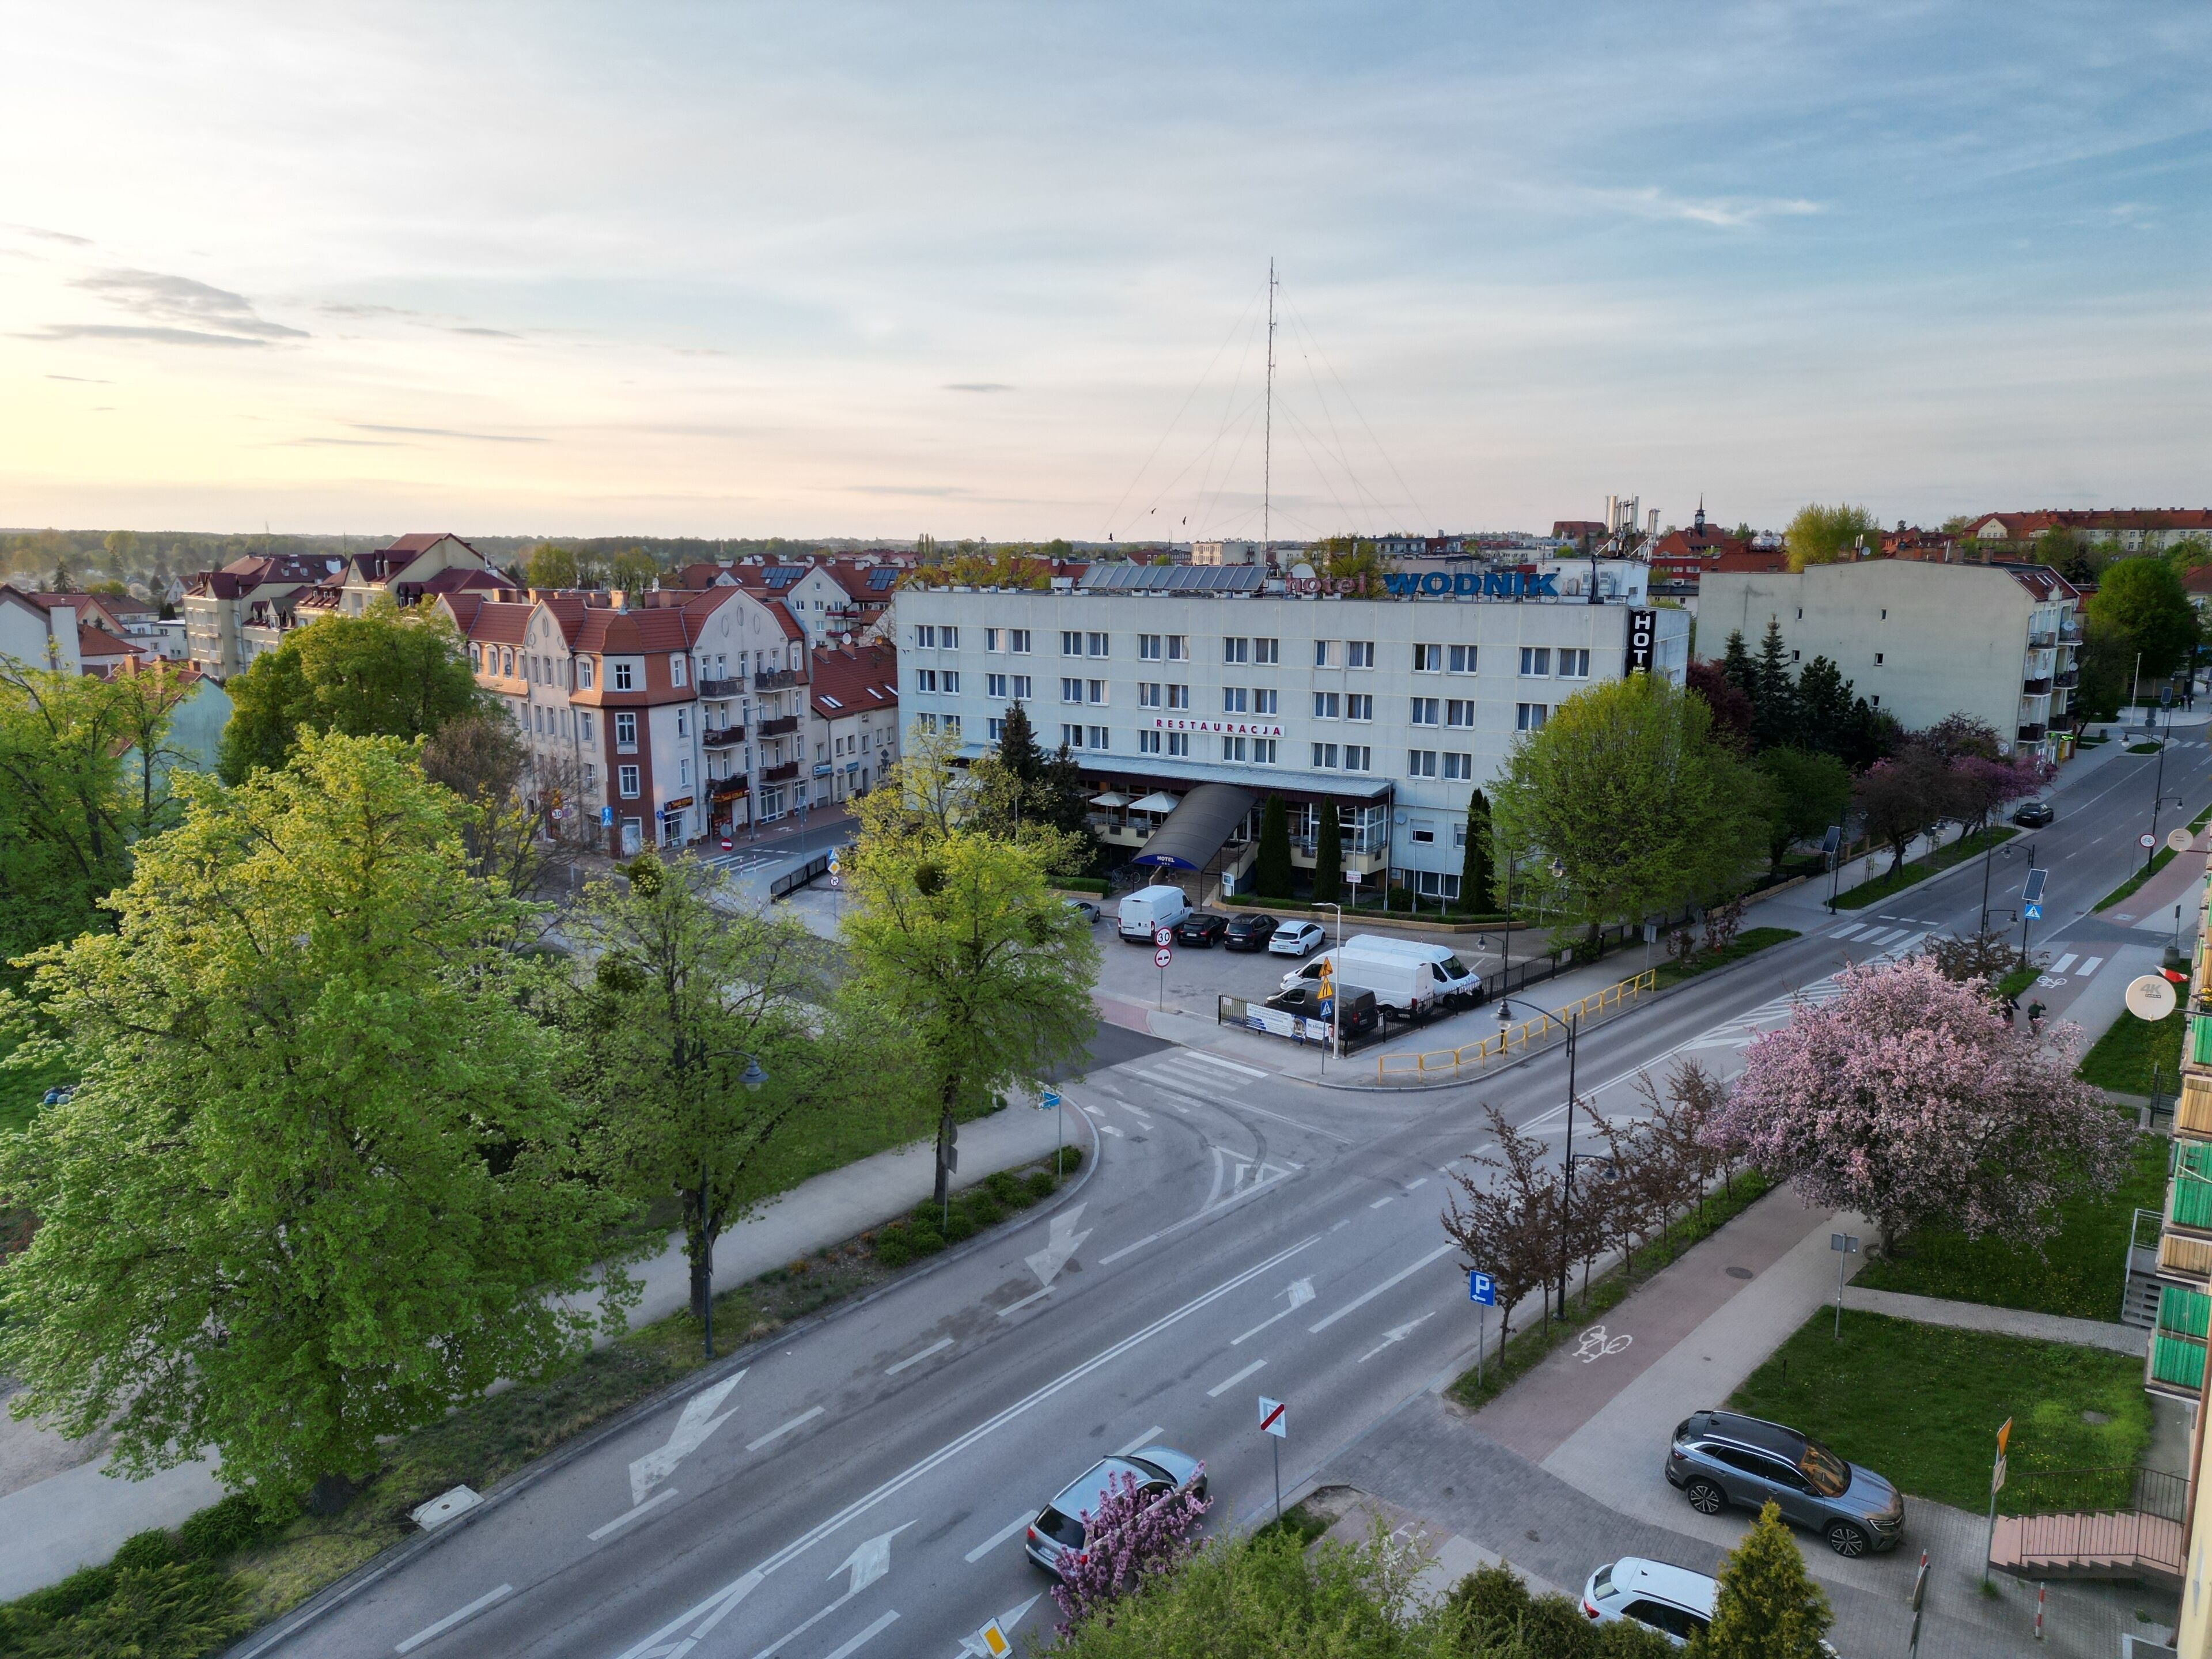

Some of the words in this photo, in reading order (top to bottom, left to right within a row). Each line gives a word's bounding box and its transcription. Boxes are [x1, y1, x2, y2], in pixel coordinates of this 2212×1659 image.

[1285, 571, 1366, 594] hotel
[1382, 571, 1560, 596] WODNIK
[1156, 719, 1281, 736] RESTAURACJA
[1158, 932, 1170, 942] 30
[2140, 983, 2162, 994] 4K
[1476, 1275, 1490, 1294] P
